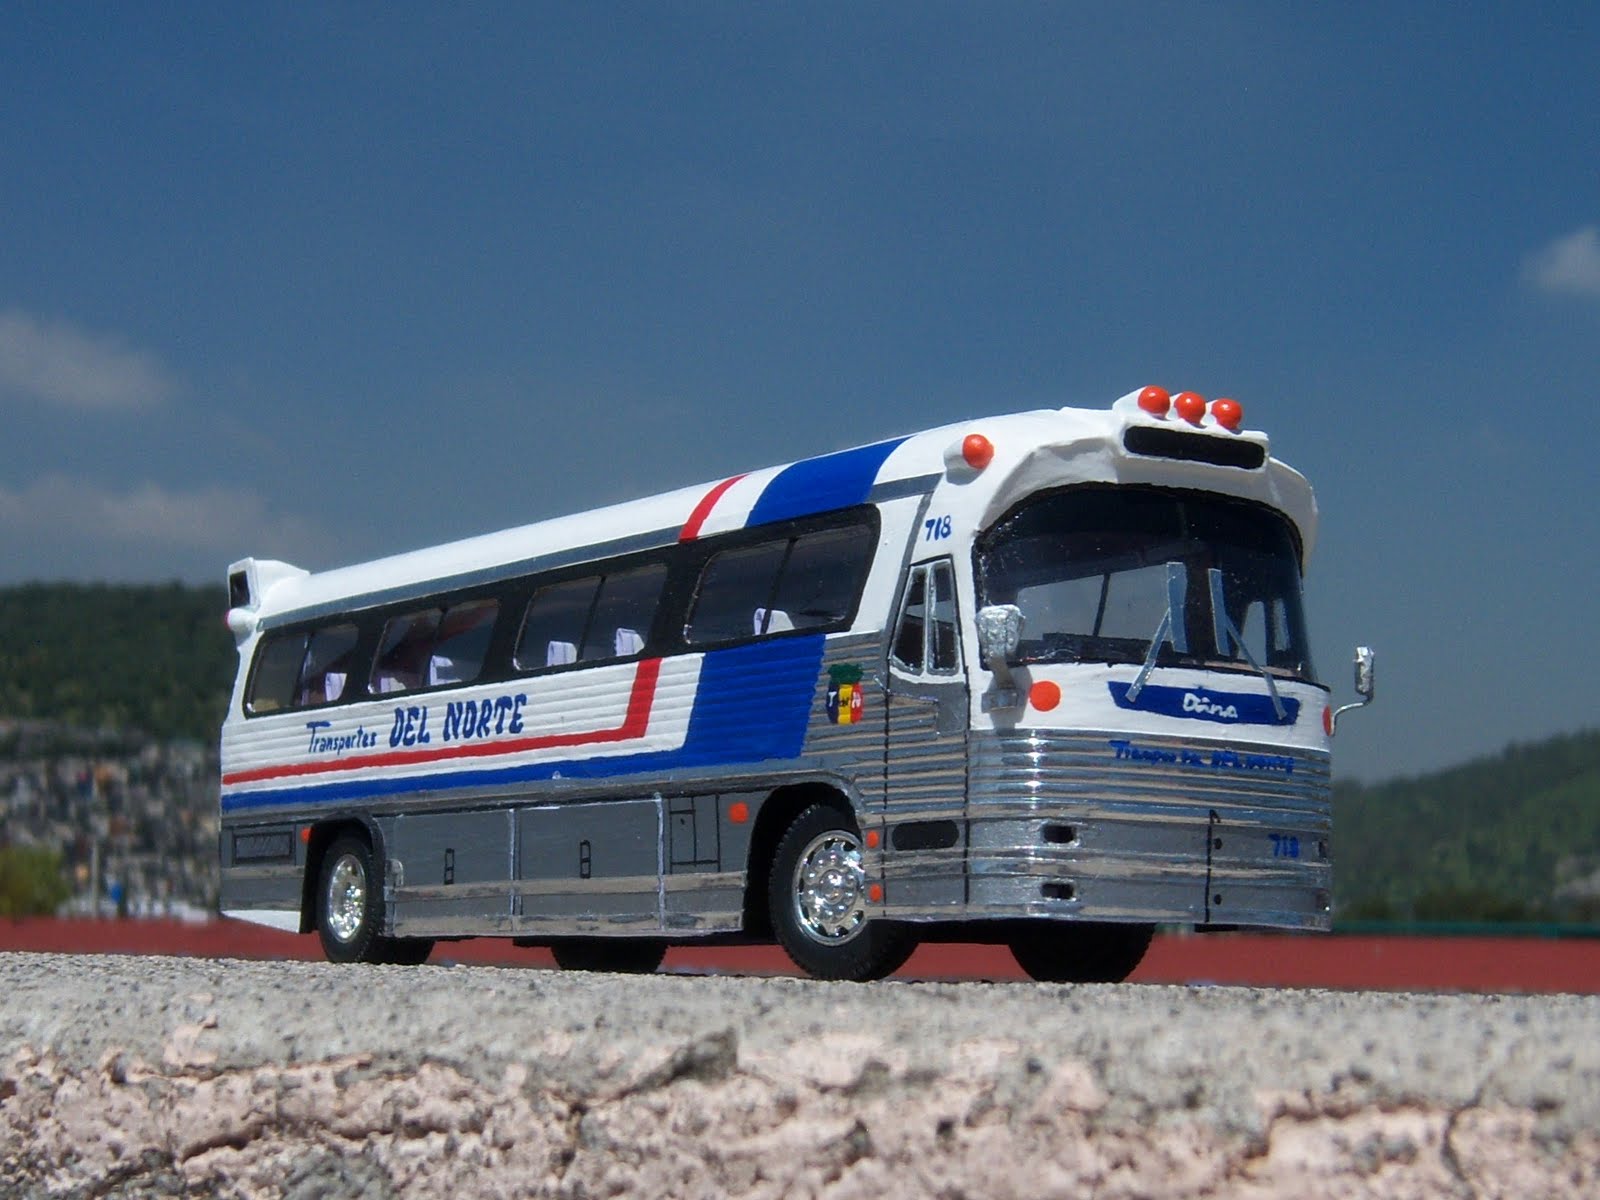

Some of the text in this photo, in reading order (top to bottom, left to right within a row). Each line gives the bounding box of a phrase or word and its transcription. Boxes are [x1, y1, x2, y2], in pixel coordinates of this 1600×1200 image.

[925, 515, 951, 541] 718
[1182, 692, 1238, 718] Dina
[306, 693, 527, 755] Transportes DEL NORTE
